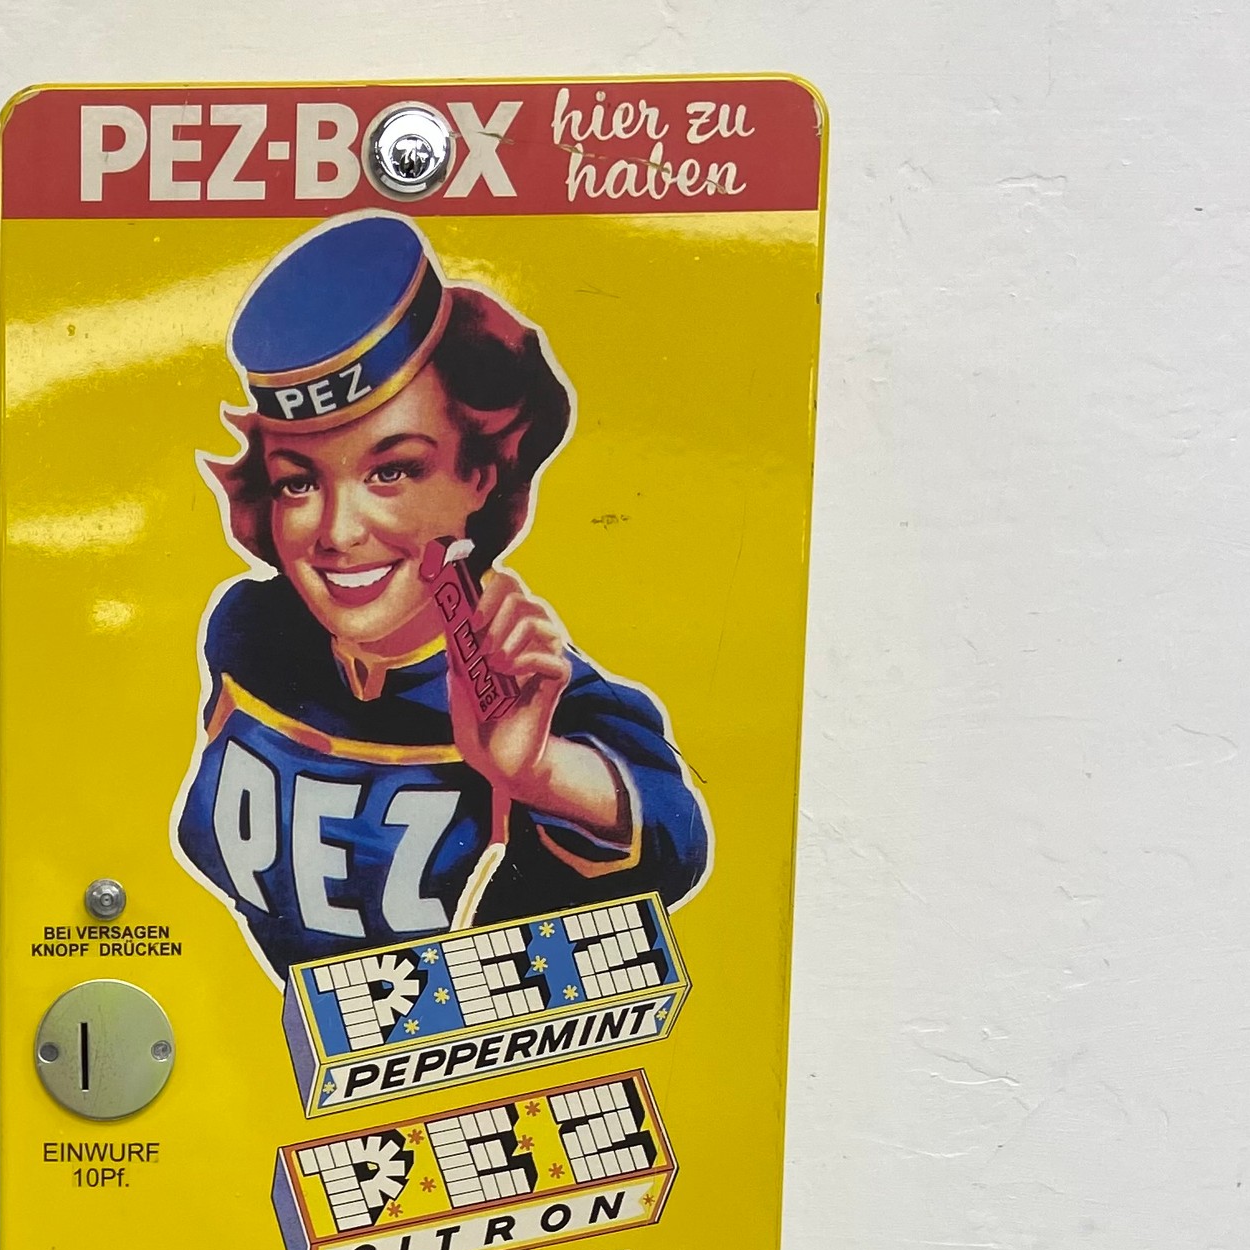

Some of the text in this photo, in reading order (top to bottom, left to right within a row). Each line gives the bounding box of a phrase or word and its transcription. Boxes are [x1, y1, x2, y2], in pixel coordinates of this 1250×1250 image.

[79, 88, 755, 201] PEZ-BX hier zu
[564, 141, 748, 202] haben
[275, 362, 372, 419] PEZ
[435, 582, 493, 698] PEZ
[213, 738, 462, 938] PEZ
[31, 939, 182, 958] KNOPF DRÜCKEN
[44, 925, 170, 941] BEI VERSAGEN
[313, 903, 661, 1051] PEZ
[344, 1002, 658, 1098] PEPPERMINT
[43, 1143, 160, 1163] EINWURF
[73, 1167, 130, 1188] 10Pf.
[297, 1082, 653, 1232] PEZ
